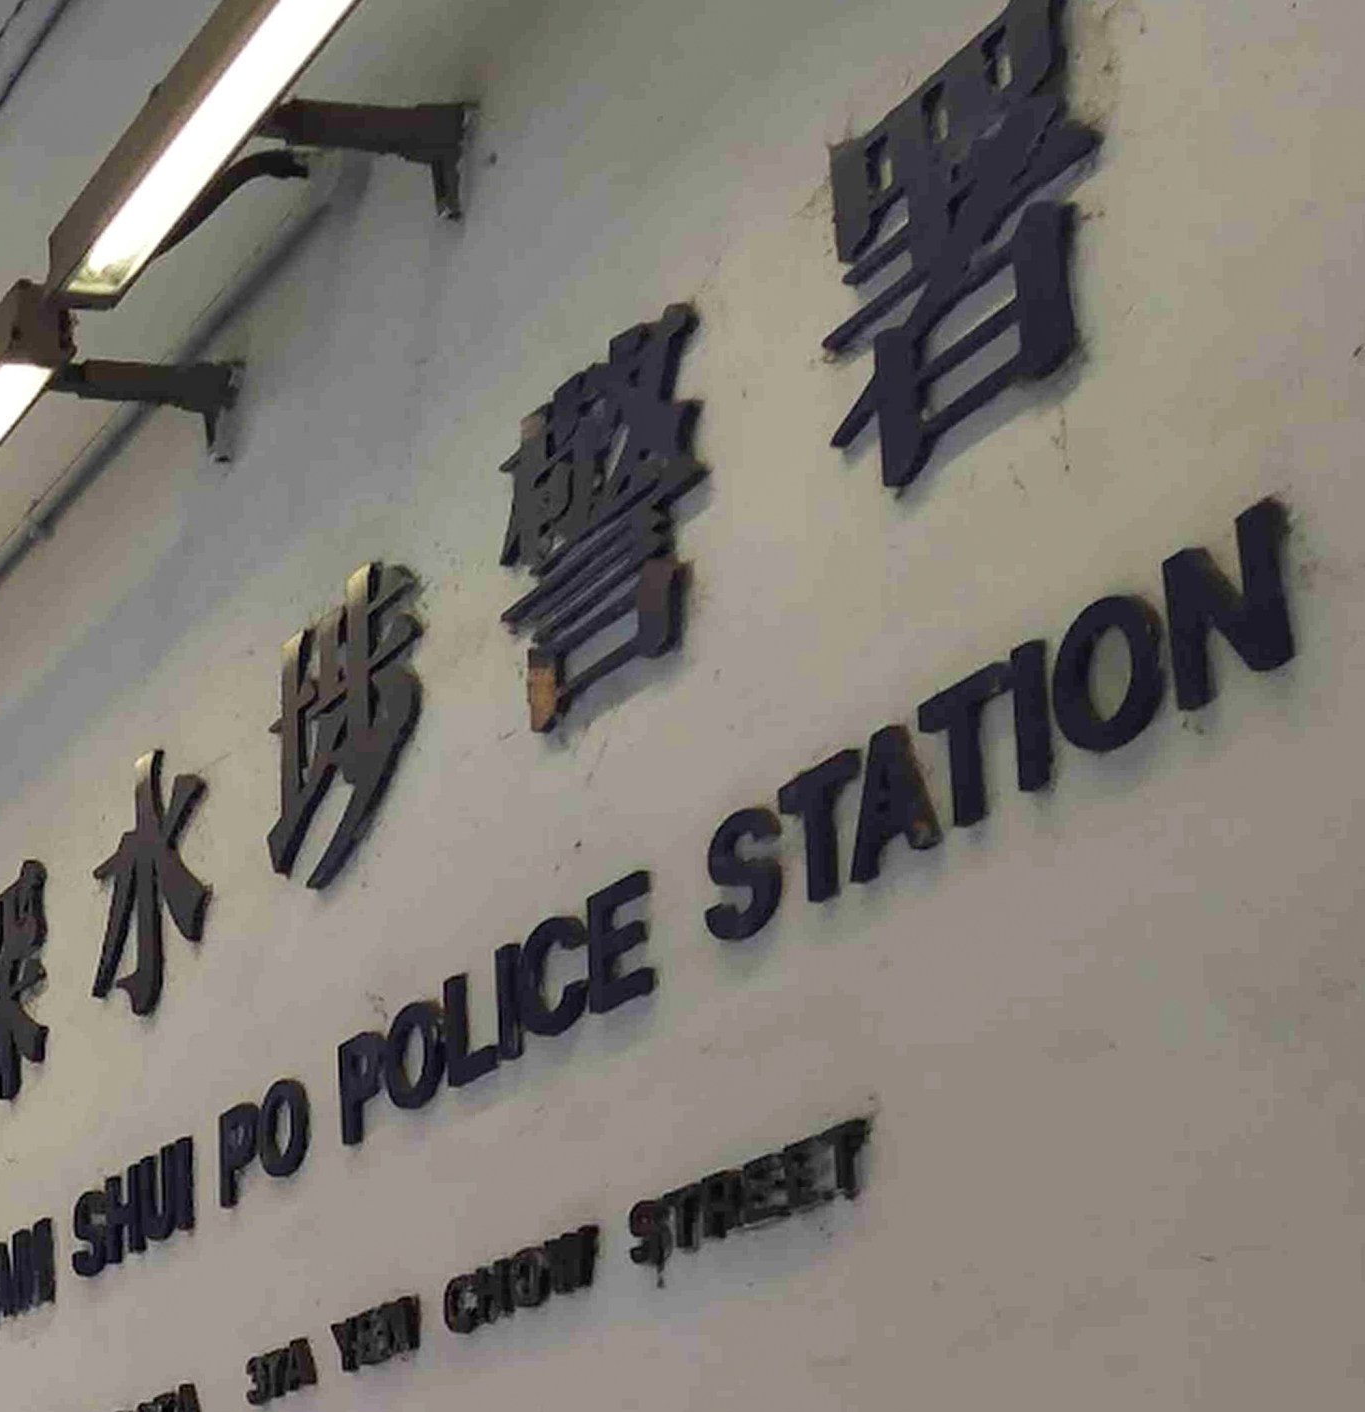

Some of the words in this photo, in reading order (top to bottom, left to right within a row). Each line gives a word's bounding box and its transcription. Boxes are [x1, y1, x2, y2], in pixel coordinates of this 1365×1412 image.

[72, 1136, 195, 1277] SHUI
[219, 1078, 311, 1208] PO
[338, 869, 656, 1144] POLICE
[705, 497, 1296, 941] STATION
[246, 1337, 317, 1405] 37A
[330, 1294, 420, 1372] YEN
[443, 1224, 599, 1334] CHOW
[629, 1117, 869, 1265] STREET
